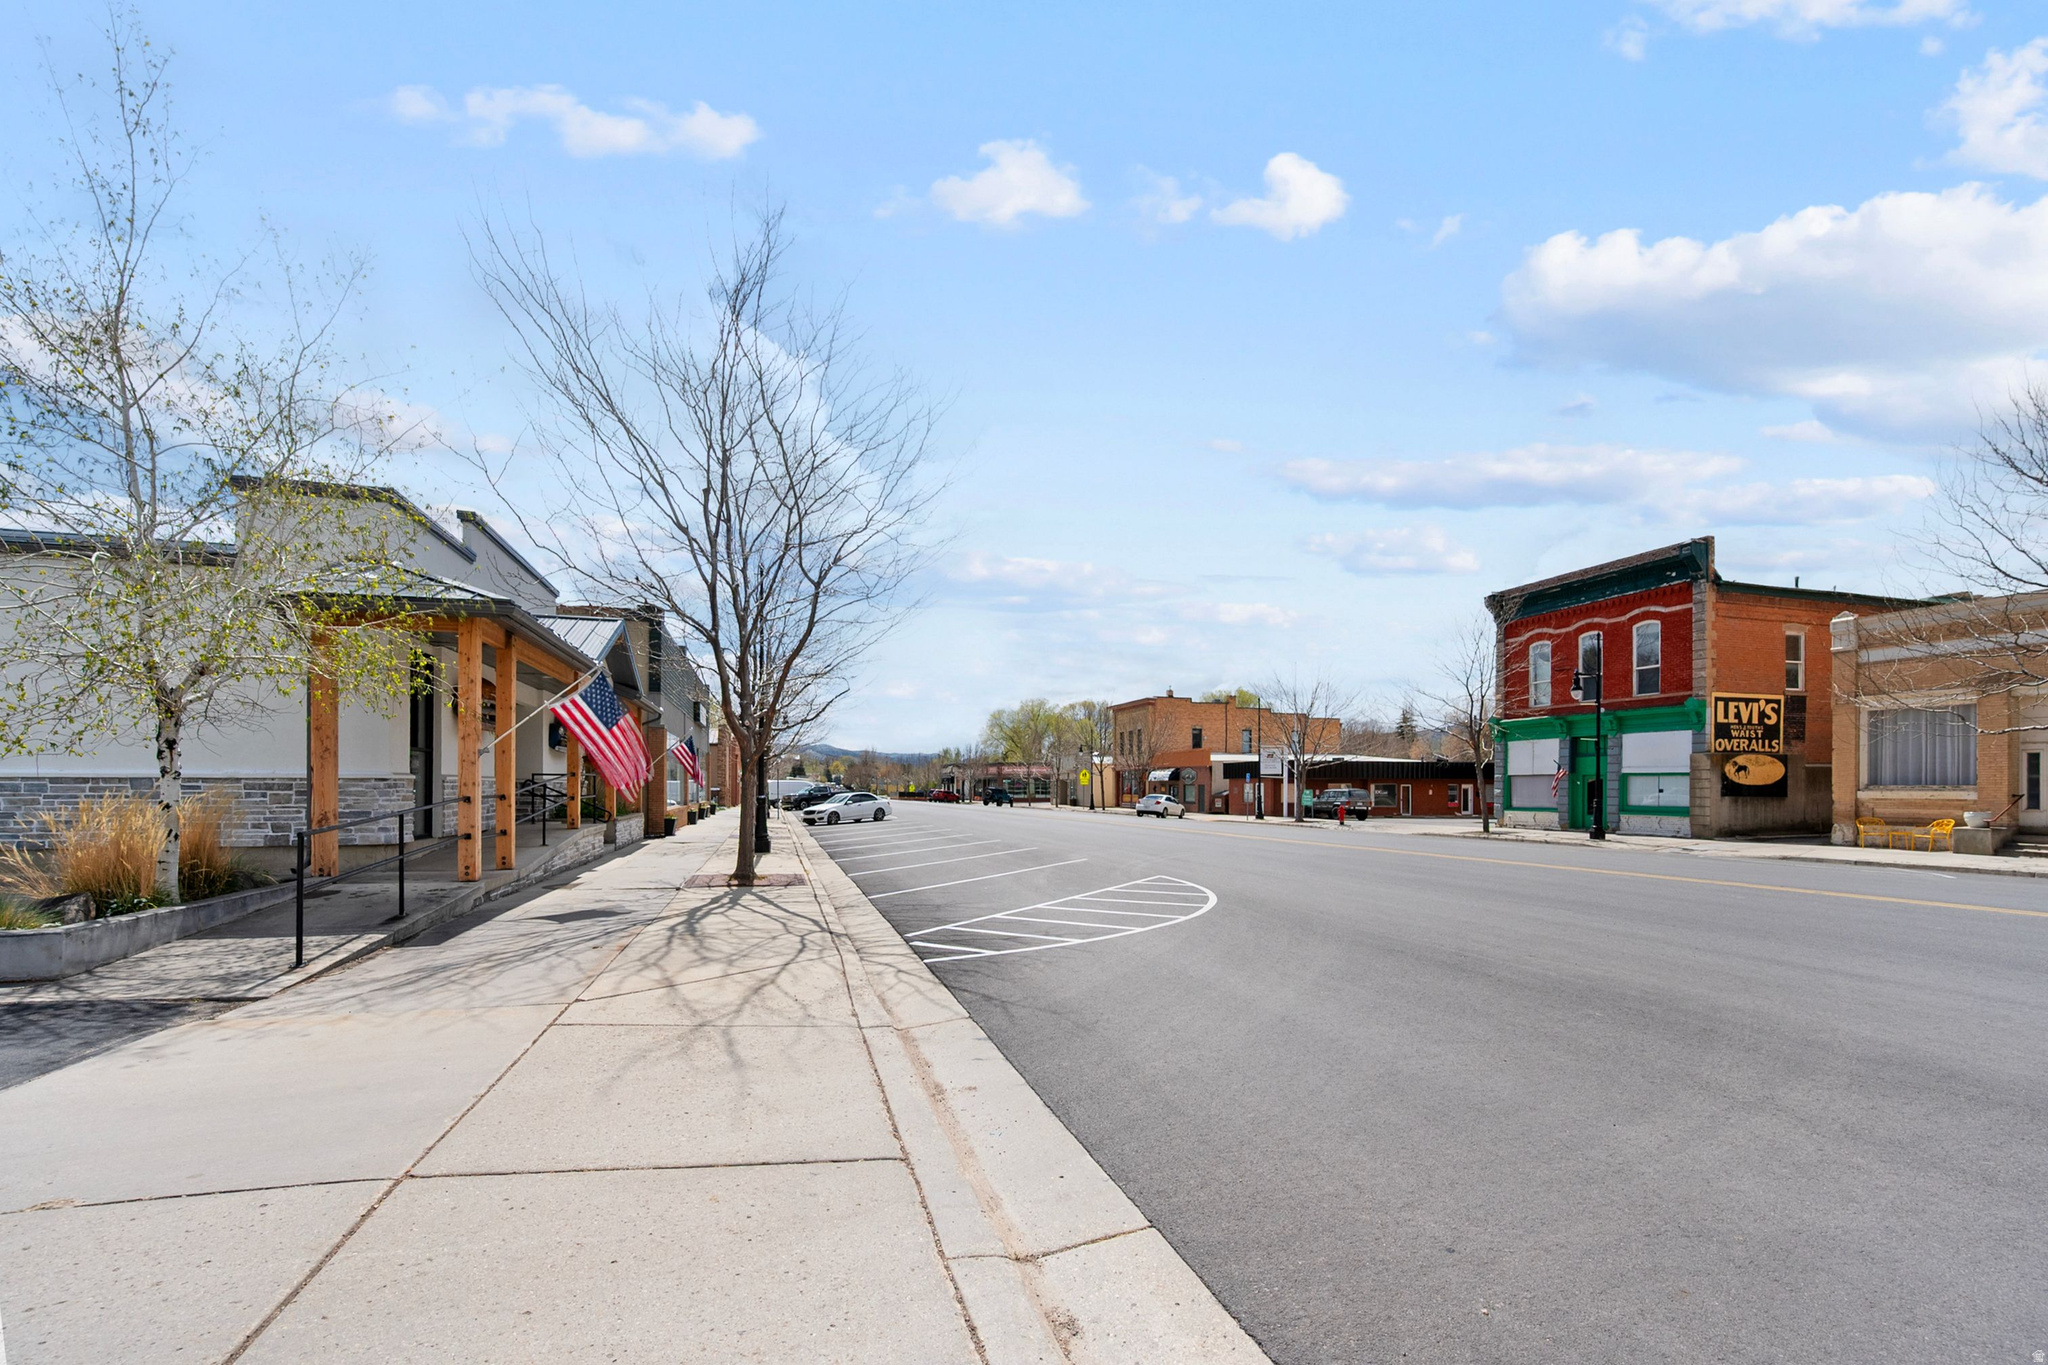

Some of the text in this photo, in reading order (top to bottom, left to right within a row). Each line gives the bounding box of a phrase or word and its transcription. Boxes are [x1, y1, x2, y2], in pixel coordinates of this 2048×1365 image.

[1717, 699, 1778, 725] LEVI'S
[1731, 730, 1763, 738] WAIST
[1715, 739, 1779, 752] OVERALLS
